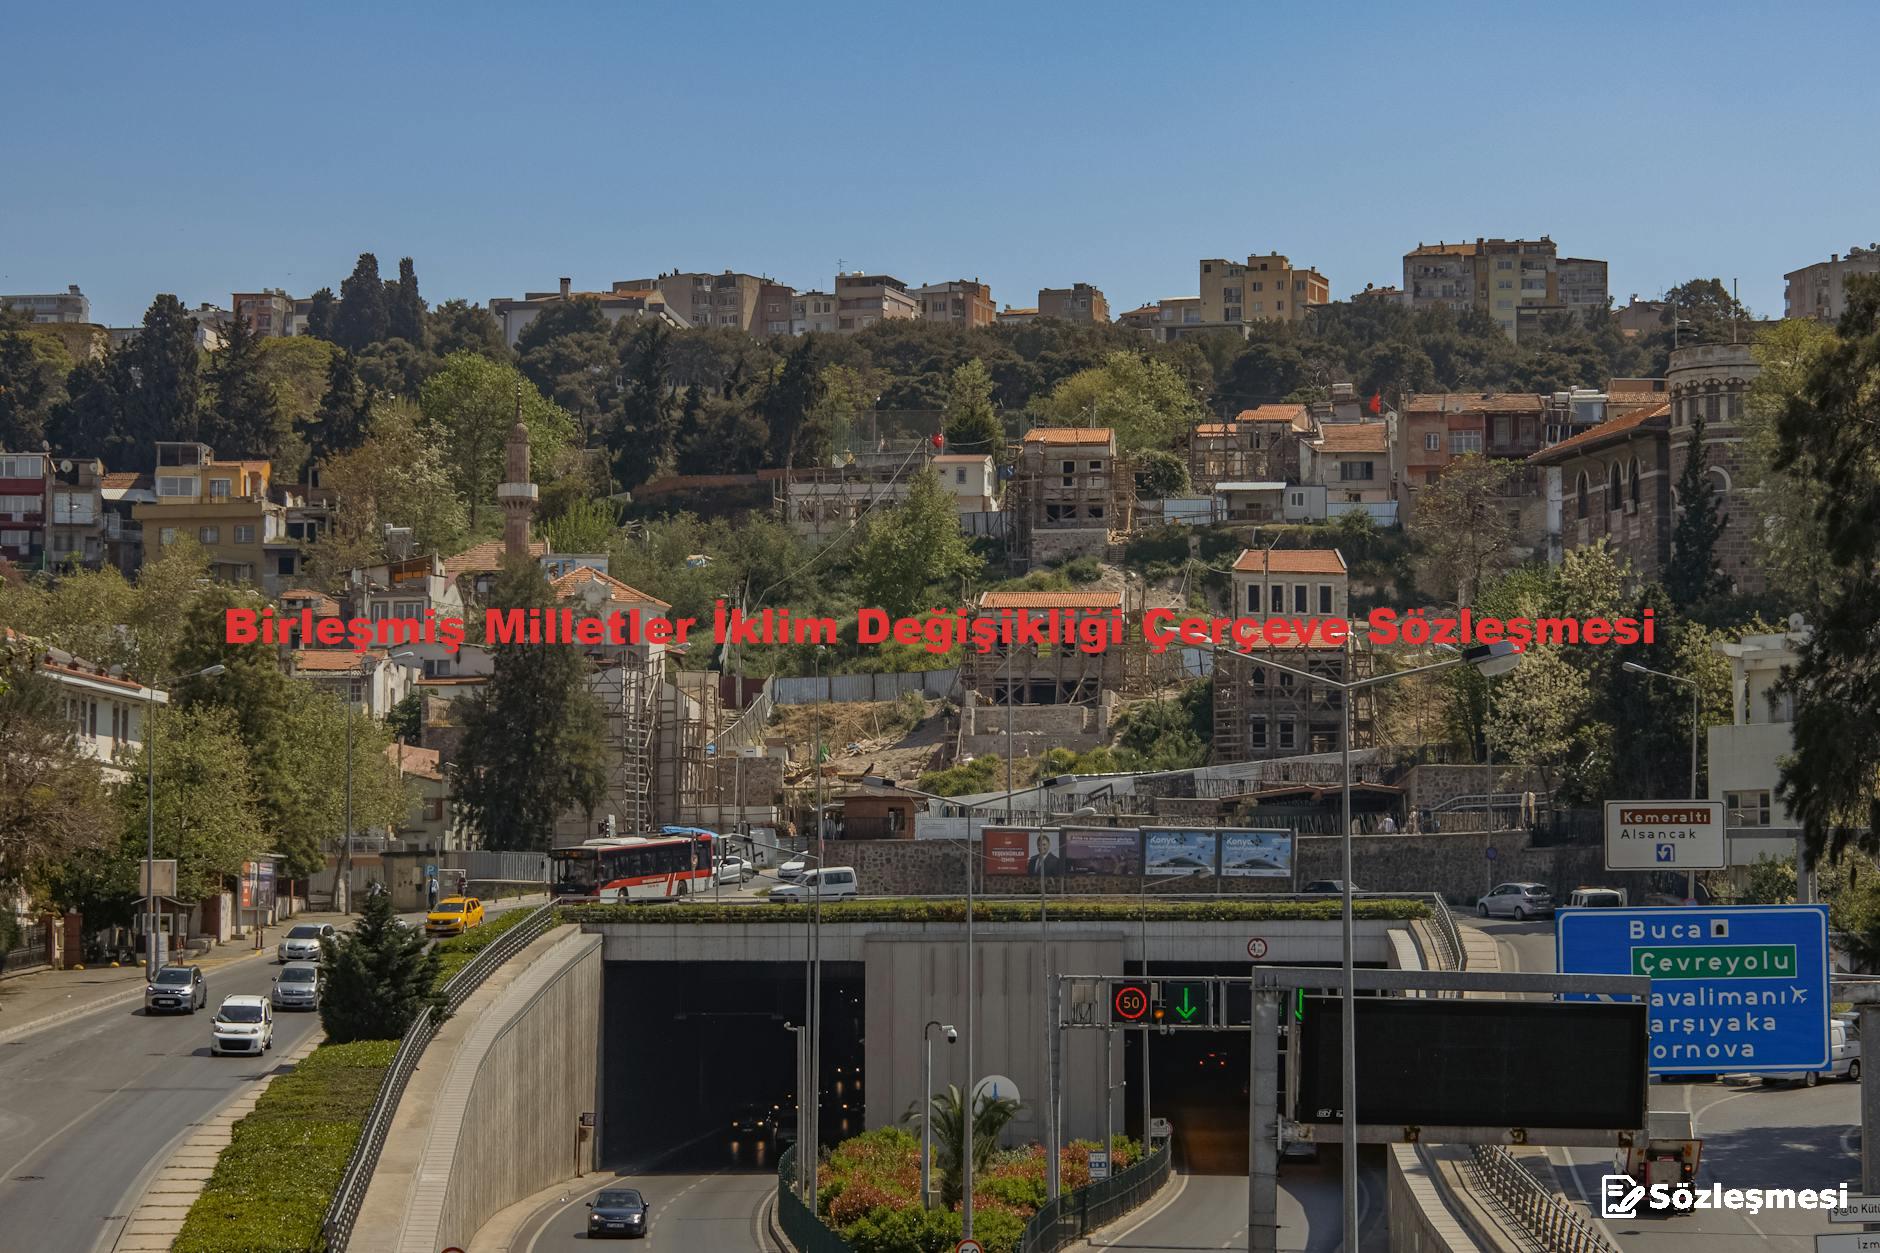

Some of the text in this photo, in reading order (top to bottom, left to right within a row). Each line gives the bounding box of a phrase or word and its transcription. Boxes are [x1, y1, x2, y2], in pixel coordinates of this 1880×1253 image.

[1624, 811, 1707, 823] Kemeraltı
[1150, 835, 1176, 848] Konya
[1620, 828, 1697, 840] Alsancak
[1226, 837, 1253, 847] Konya
[1630, 920, 1701, 940] Buca
[1640, 951, 1789, 976] Çevreyolu
[1123, 996, 1140, 1009] 50
[1634, 987, 1786, 1007] avalimanı
[1651, 1012, 1776, 1037] arşıyaka
[1653, 1043, 1755, 1060] ornova
